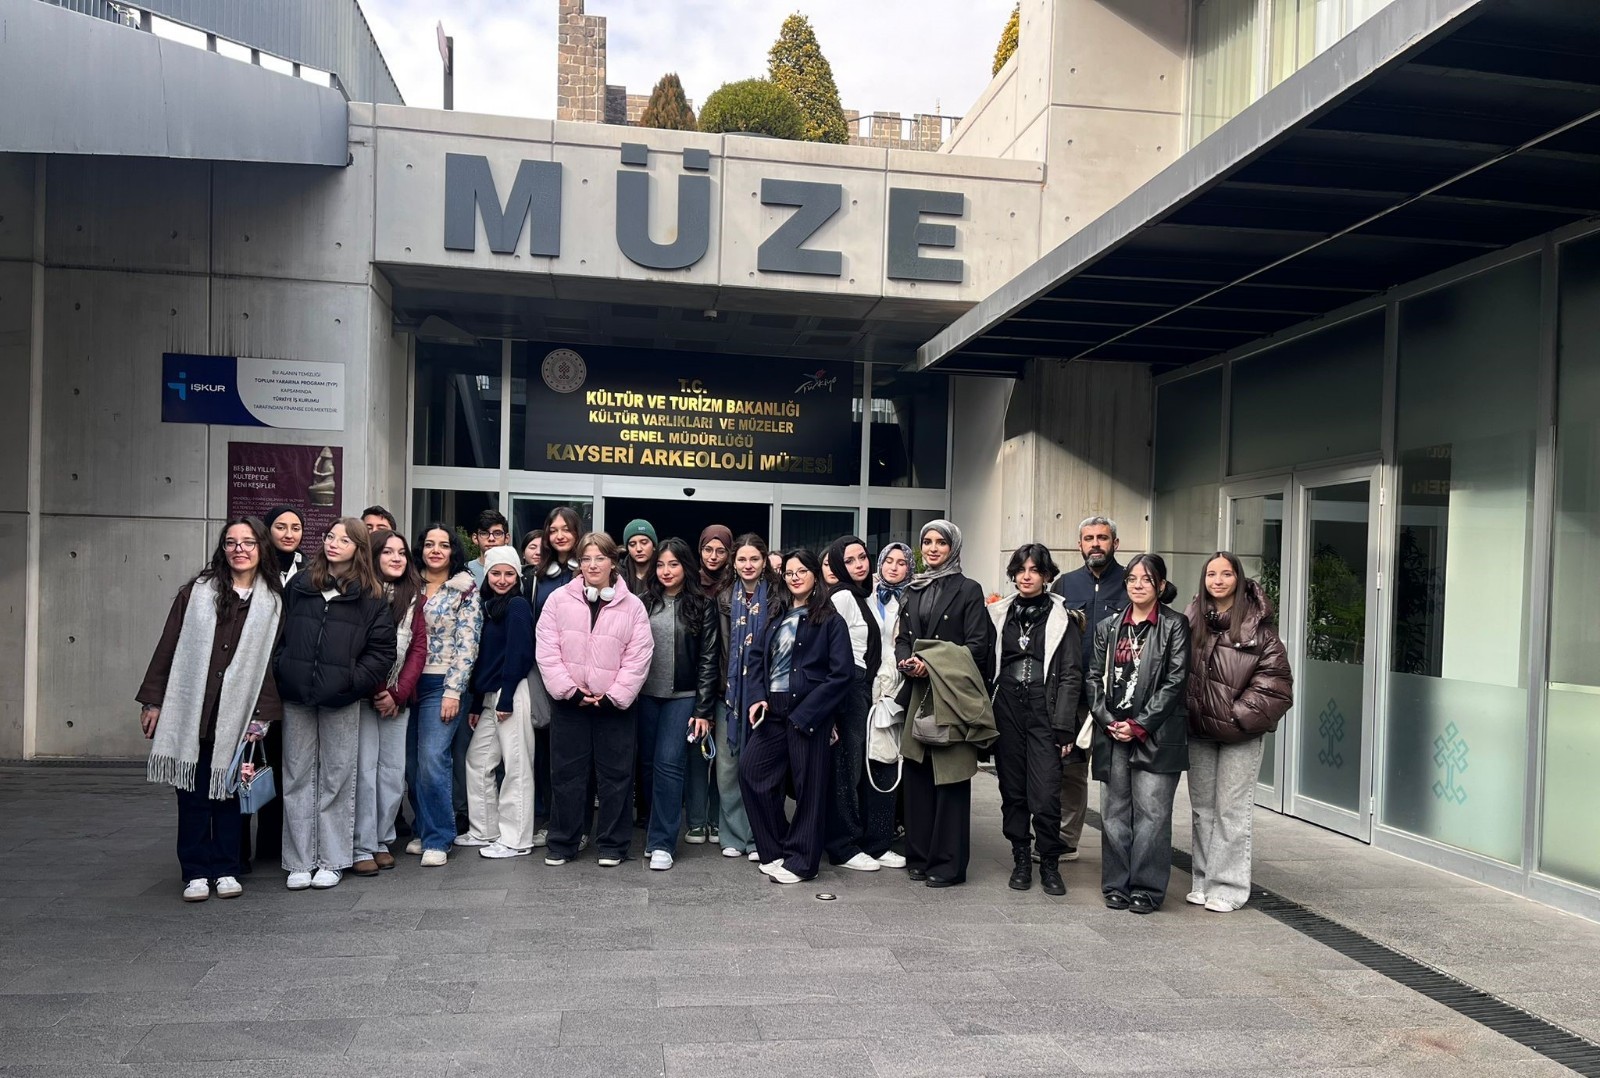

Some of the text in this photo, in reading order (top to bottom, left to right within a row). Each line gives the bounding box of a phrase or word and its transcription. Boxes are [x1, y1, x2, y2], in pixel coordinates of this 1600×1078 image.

[444, 142, 965, 284] MÜZE
[678, 378, 708, 394] T.C.
[586, 389, 801, 417] KÜLTÜR VE TURİZM BAKANLIĞI
[589, 409, 794, 434] KÜLTÜR VARLIKLARI VE MÜZELER
[620, 429, 754, 448] GENEL MÜDÜRLÜĞÜ
[546, 443, 833, 474] KAYSERİ ARKEOLOJİ MÜZESİ
